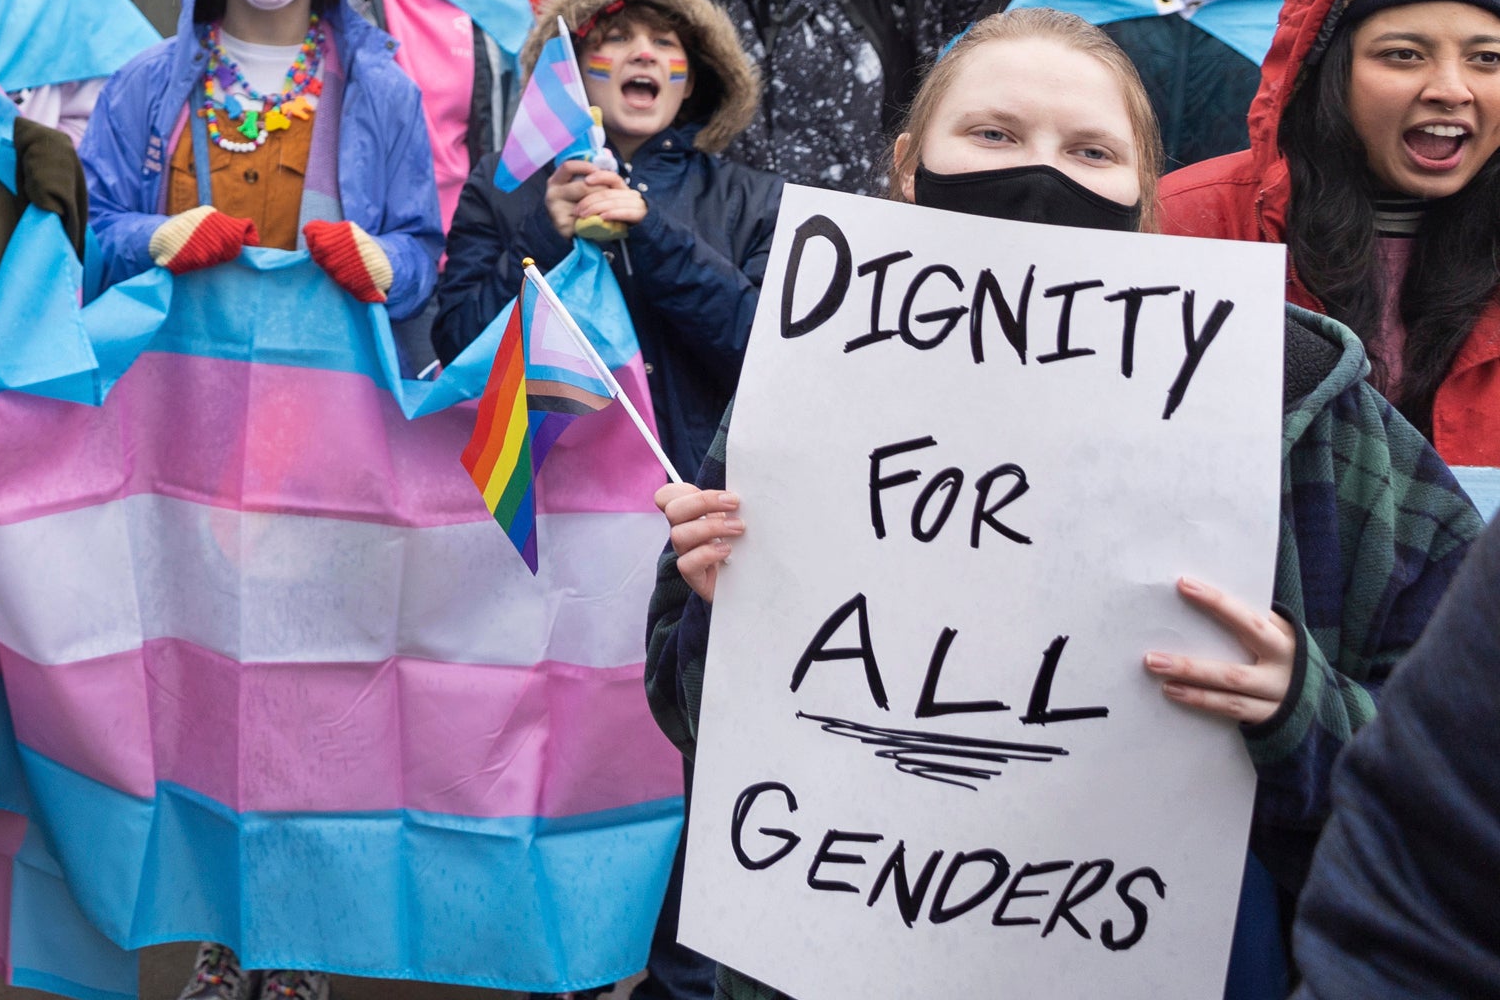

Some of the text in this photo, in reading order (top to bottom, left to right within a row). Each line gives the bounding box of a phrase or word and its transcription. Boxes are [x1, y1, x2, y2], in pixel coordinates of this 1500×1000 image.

[779, 213, 1235, 420] DIGNITY
[868, 436, 1033, 549] FOR
[789, 592, 1110, 726] ALL
[730, 781, 1166, 952] GENDERS
